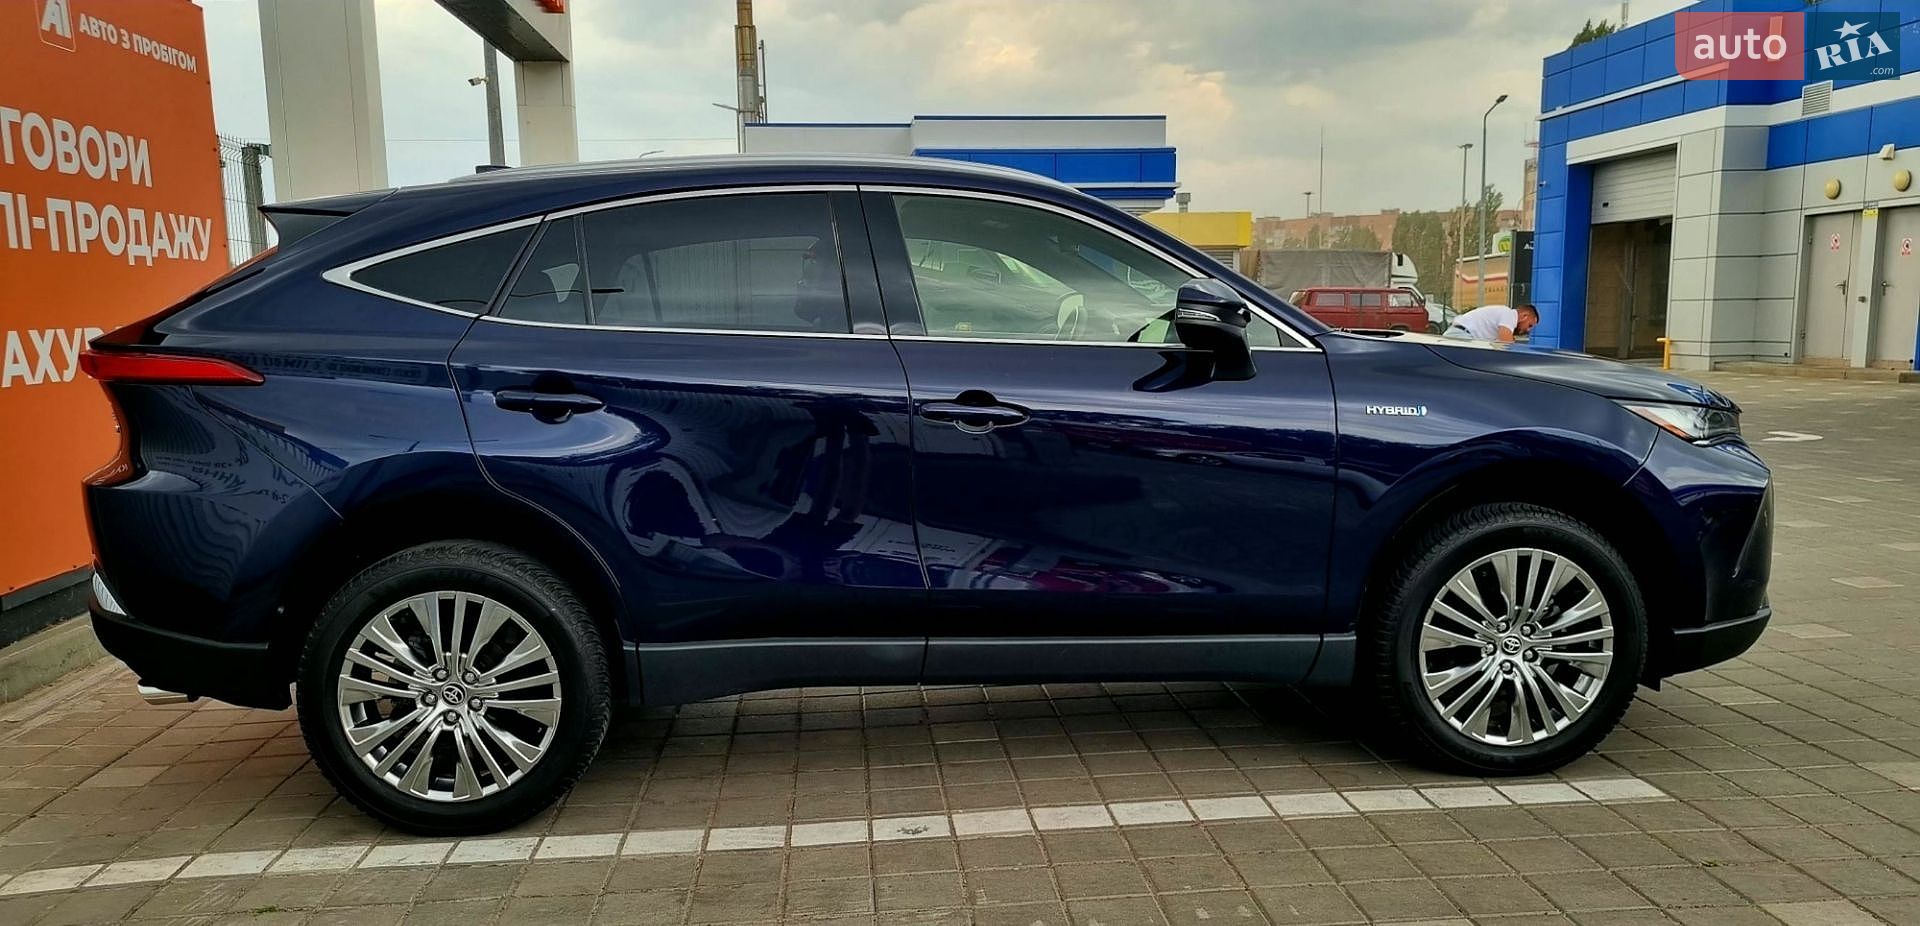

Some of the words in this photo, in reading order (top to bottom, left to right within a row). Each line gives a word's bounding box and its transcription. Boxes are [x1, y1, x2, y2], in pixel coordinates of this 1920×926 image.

[79, 13, 118, 45] АВТО
[133, 33, 197, 73] ПРОБІГОМ
[1366, 405, 1418, 416] HYBRID
